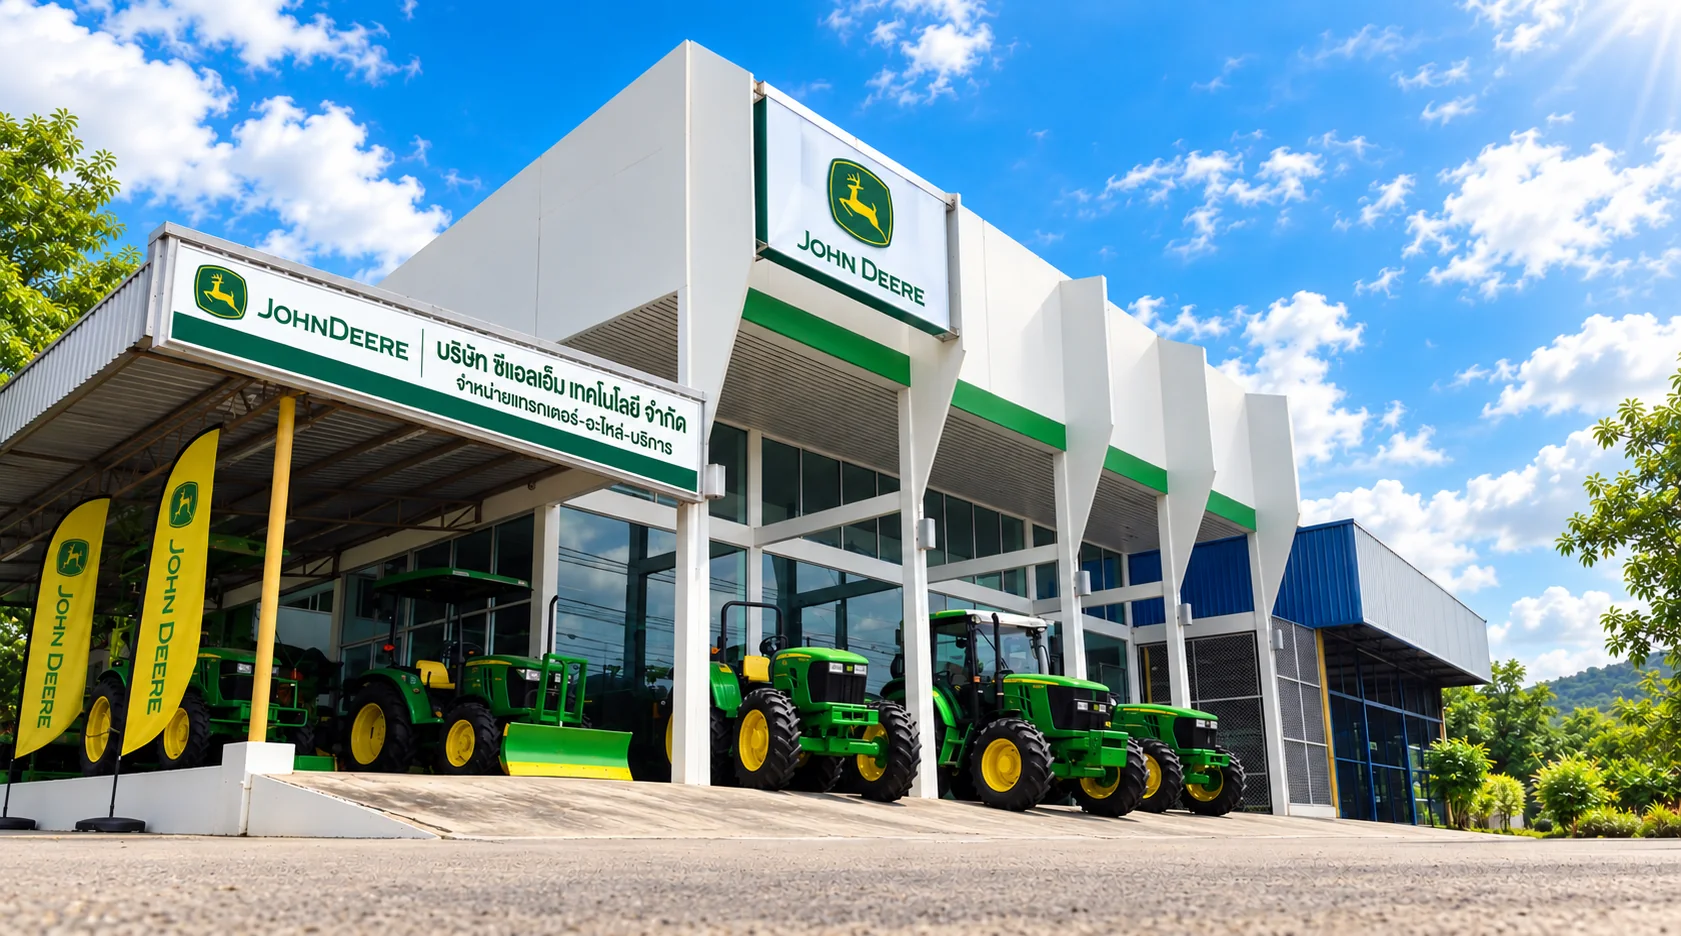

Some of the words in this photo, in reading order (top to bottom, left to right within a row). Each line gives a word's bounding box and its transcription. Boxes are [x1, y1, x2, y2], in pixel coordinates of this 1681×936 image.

[797, 231, 856, 275] JOHN
[862, 257, 926, 307] DEERE
[437, 340, 488, 373] บริษัท
[493, 353, 565, 396] ซีแอลเอ็ม
[569, 381, 640, 419] เทคโนโลยี
[644, 400, 687, 434] จำกัด
[161, 539, 185, 615] JOHN
[50, 584, 74, 647] JOHN
[36, 653, 64, 729] DEERE
[146, 621, 175, 715] DEERE
